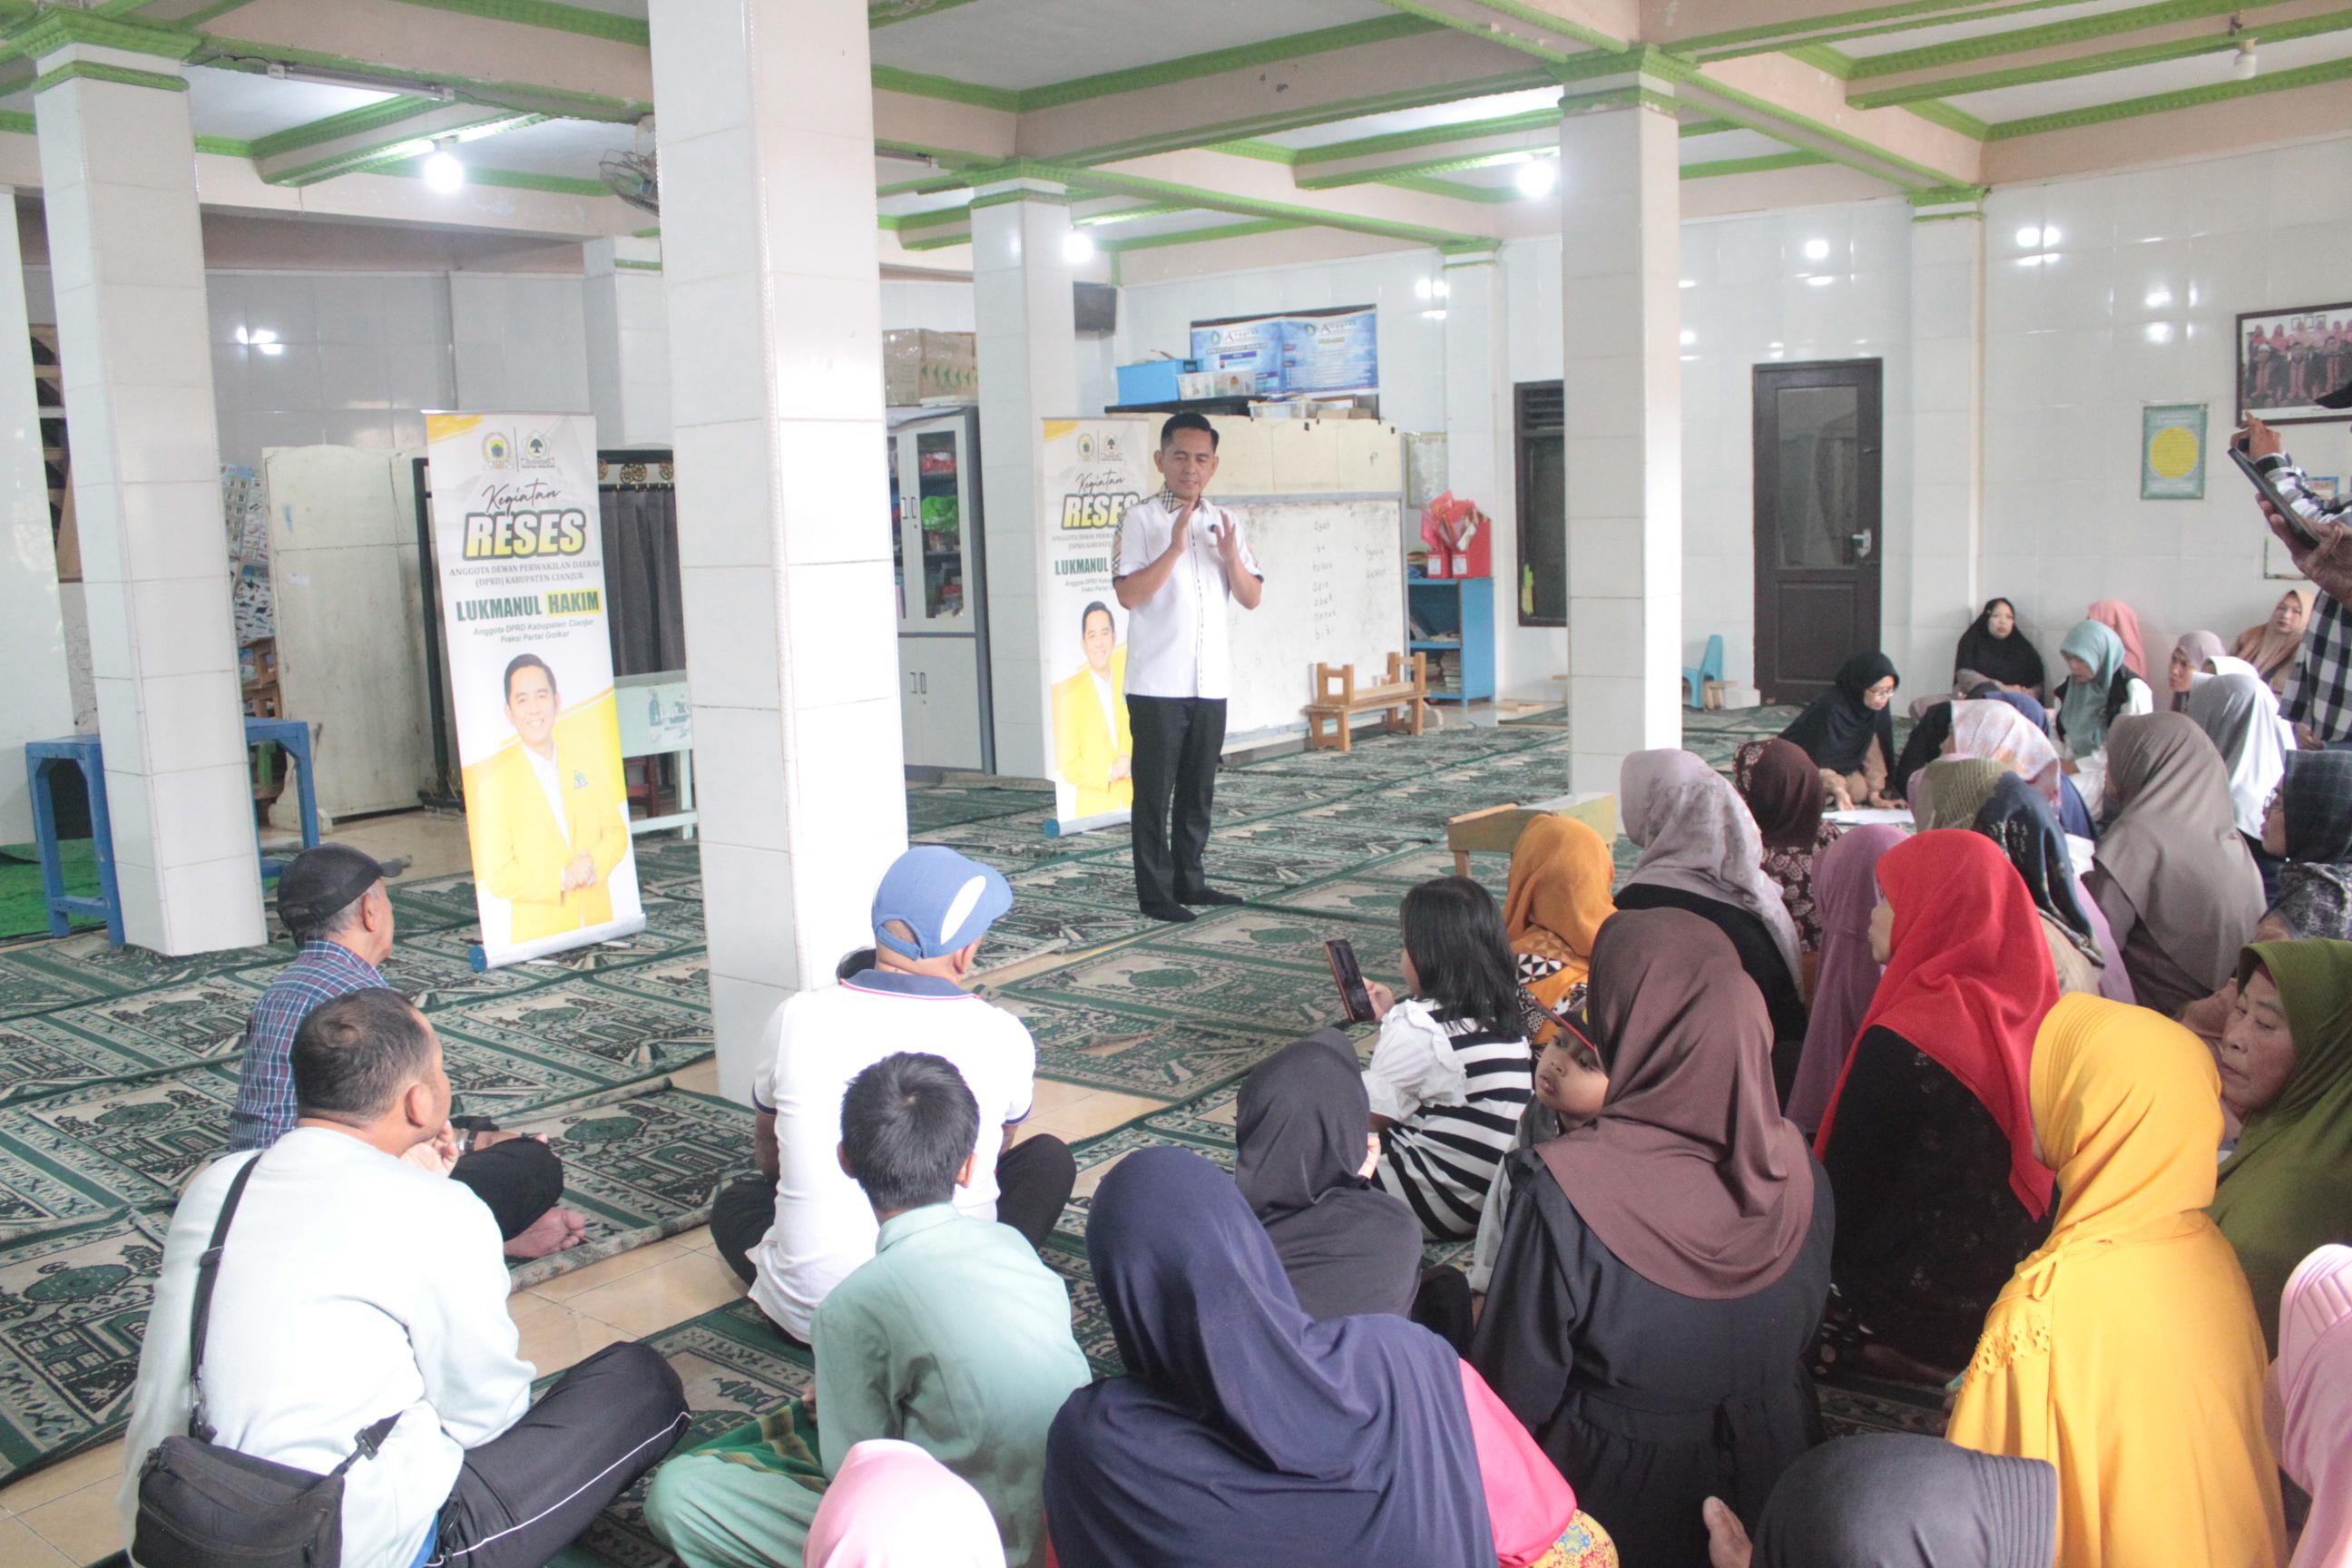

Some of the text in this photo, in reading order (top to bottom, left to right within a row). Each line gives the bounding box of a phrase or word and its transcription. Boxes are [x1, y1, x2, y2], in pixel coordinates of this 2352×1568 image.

[1075, 468, 1125, 496] Kegiatan
[481, 478, 561, 516] Kegiatan
[463, 508, 586, 560] RESES
[449, 566, 491, 576] ANGGOTA
[491, 565, 518, 573] DEWAN
[519, 562, 572, 573] PERWAKILAN
[505, 573, 550, 583] KABUPATEN
[552, 572, 584, 581] CIANJUR
[1054, 557, 1109, 575] LUKMANUL
[456, 591, 600, 622] LUKMANUL HAKIM
[473, 619, 594, 637] Anggota DPRD Kabupaten Cianjur
